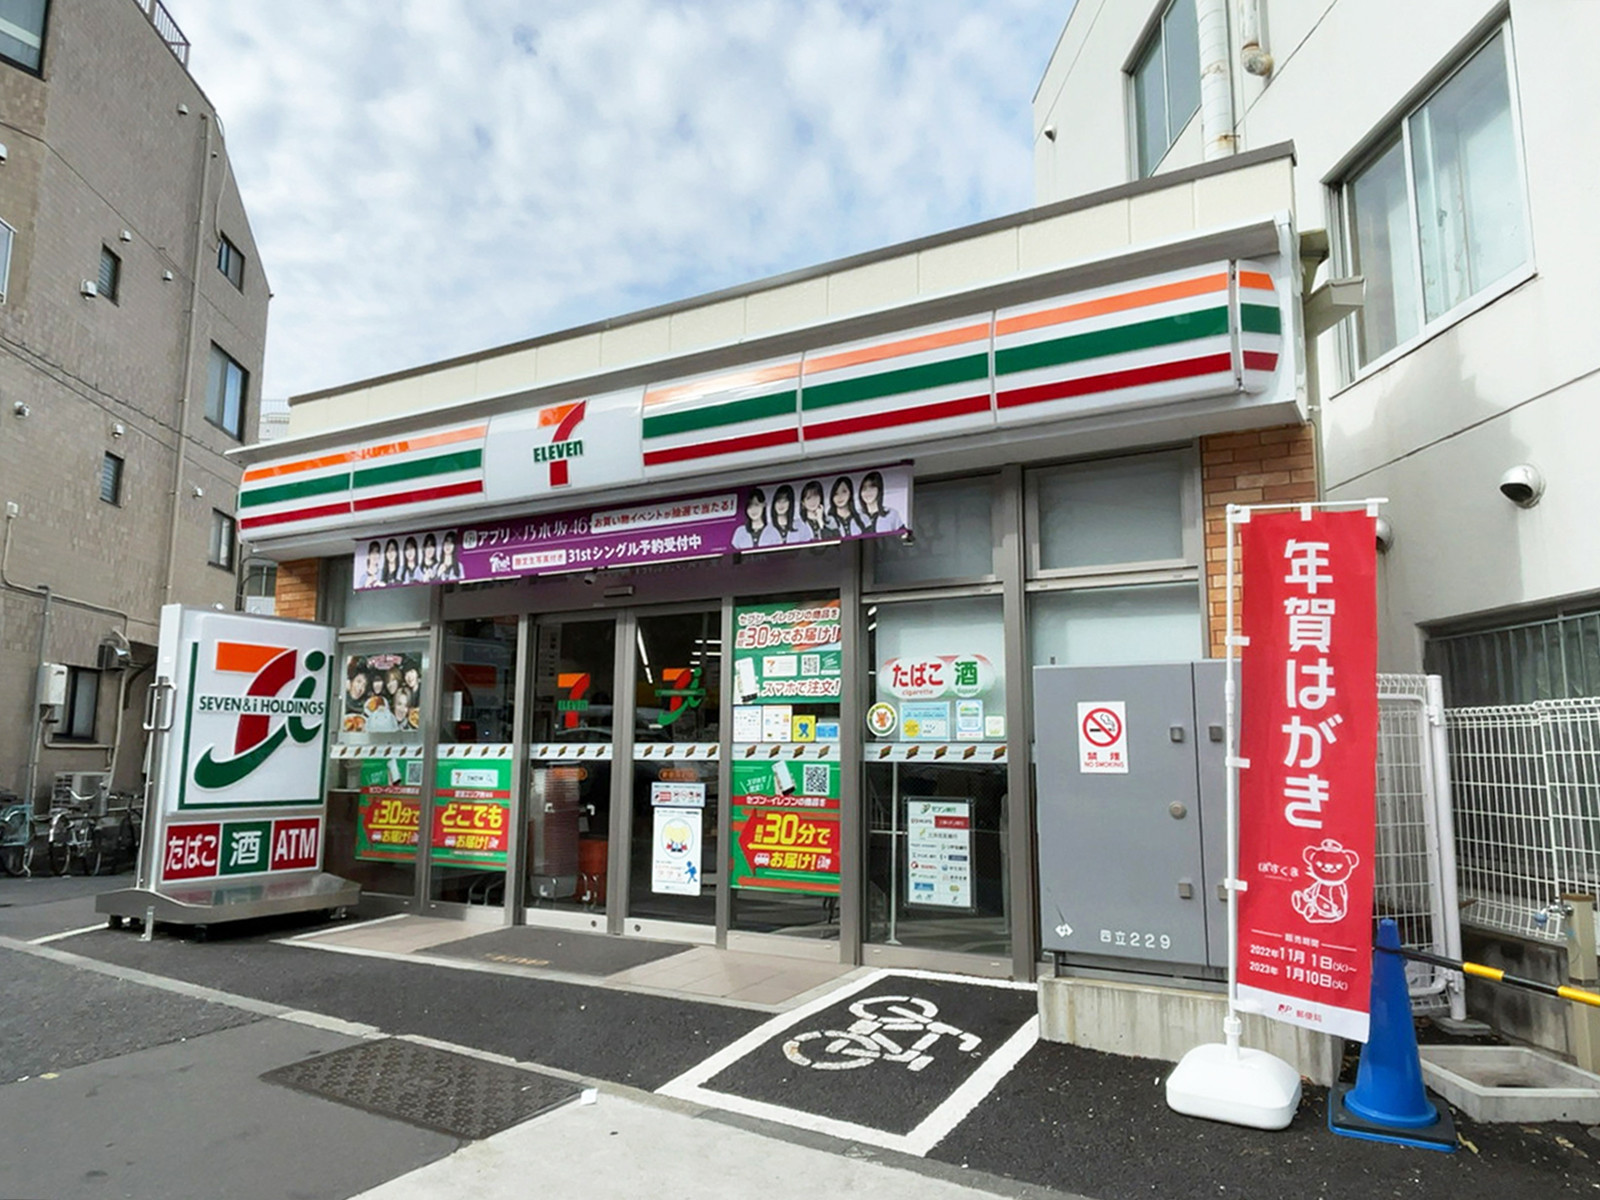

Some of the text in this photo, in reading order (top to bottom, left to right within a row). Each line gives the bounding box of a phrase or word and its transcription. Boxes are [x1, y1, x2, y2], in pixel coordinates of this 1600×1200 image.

[893, 662, 944, 688] たばこ
[954, 661, 978, 686] 酒
[1282, 539, 1343, 829] 年賀はがき
[902, 688, 933, 696] cigarette
[261, 698, 324, 716] HOLDINGS
[441, 804, 502, 829] どこでも
[166, 834, 217, 871] たばこ
[229, 831, 262, 867] 酒
[275, 828, 317, 862] ATM
[770, 852, 816, 870] お届け!
